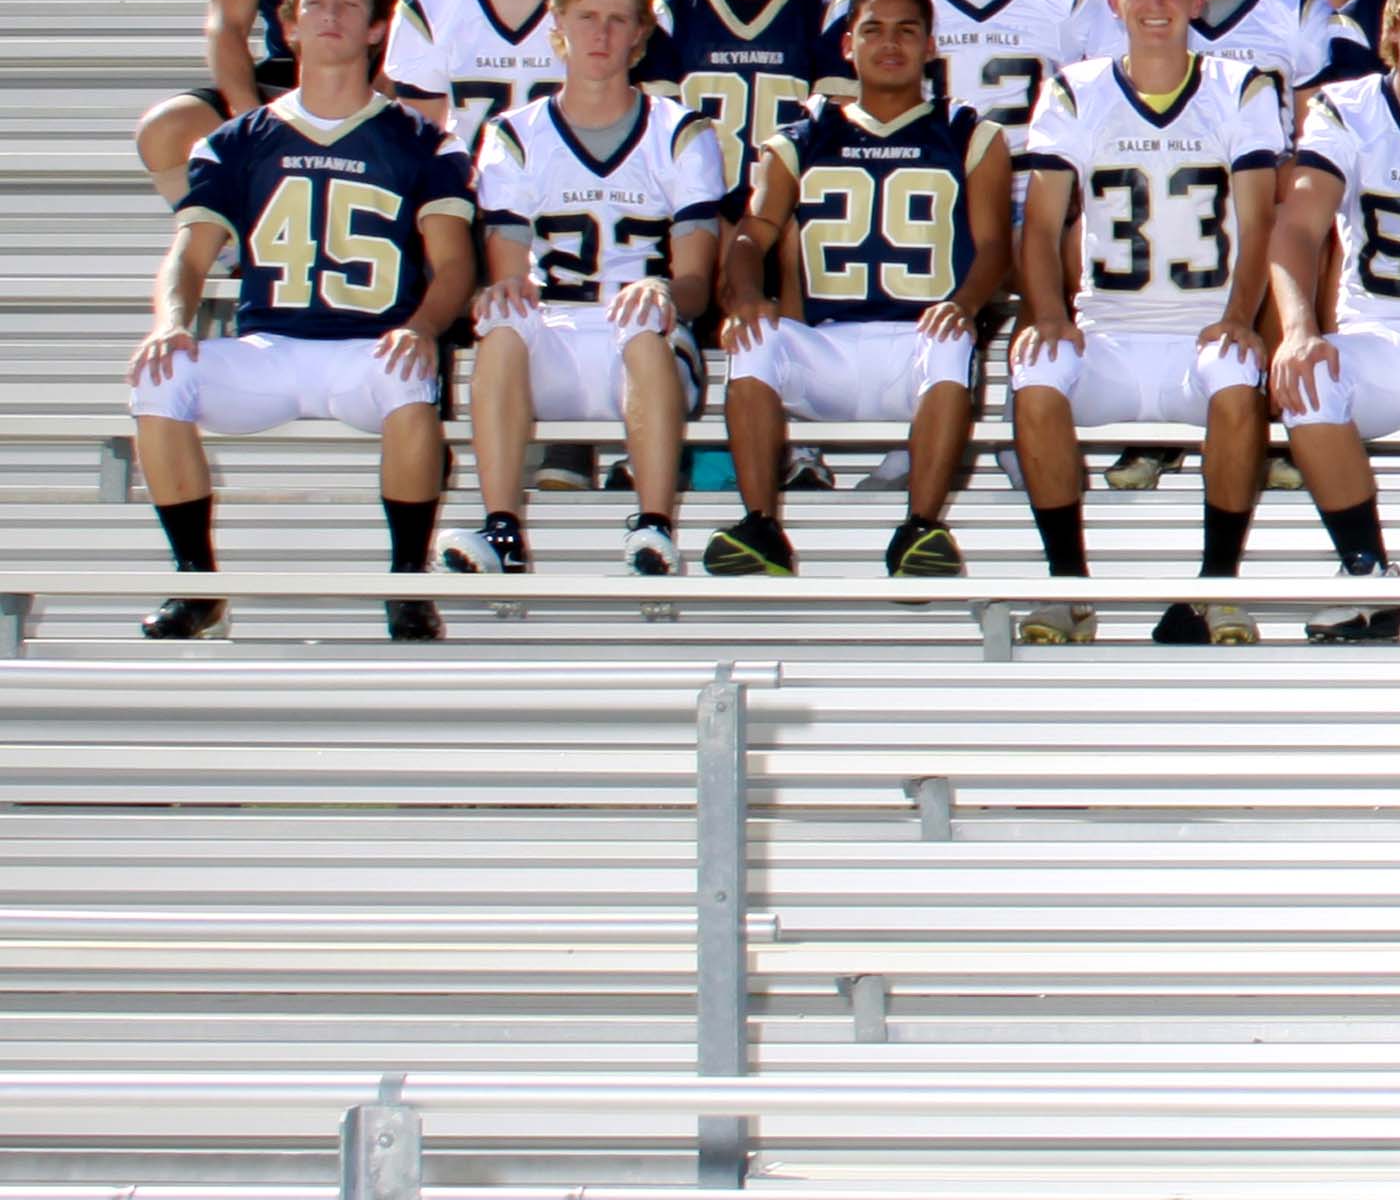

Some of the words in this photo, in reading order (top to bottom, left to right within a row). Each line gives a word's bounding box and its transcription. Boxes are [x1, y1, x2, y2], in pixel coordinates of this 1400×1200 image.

[938, 33, 979, 45] SALEM
[986, 34, 1020, 46] HILLS
[475, 57, 517, 68] SALEM
[522, 57, 551, 68] HILLS
[711, 51, 784, 65] SKYHAWKS
[842, 146, 921, 160] SKYHAWKS
[1118, 140, 1161, 153] SALEM
[1167, 140, 1201, 152] HILLS
[282, 156, 366, 174] SKYHAWKS
[562, 191, 603, 204] SALEM
[609, 192, 645, 205] HILLS
[799, 166, 959, 300] 29
[1091, 164, 1230, 291] 33
[249, 175, 402, 314] 45
